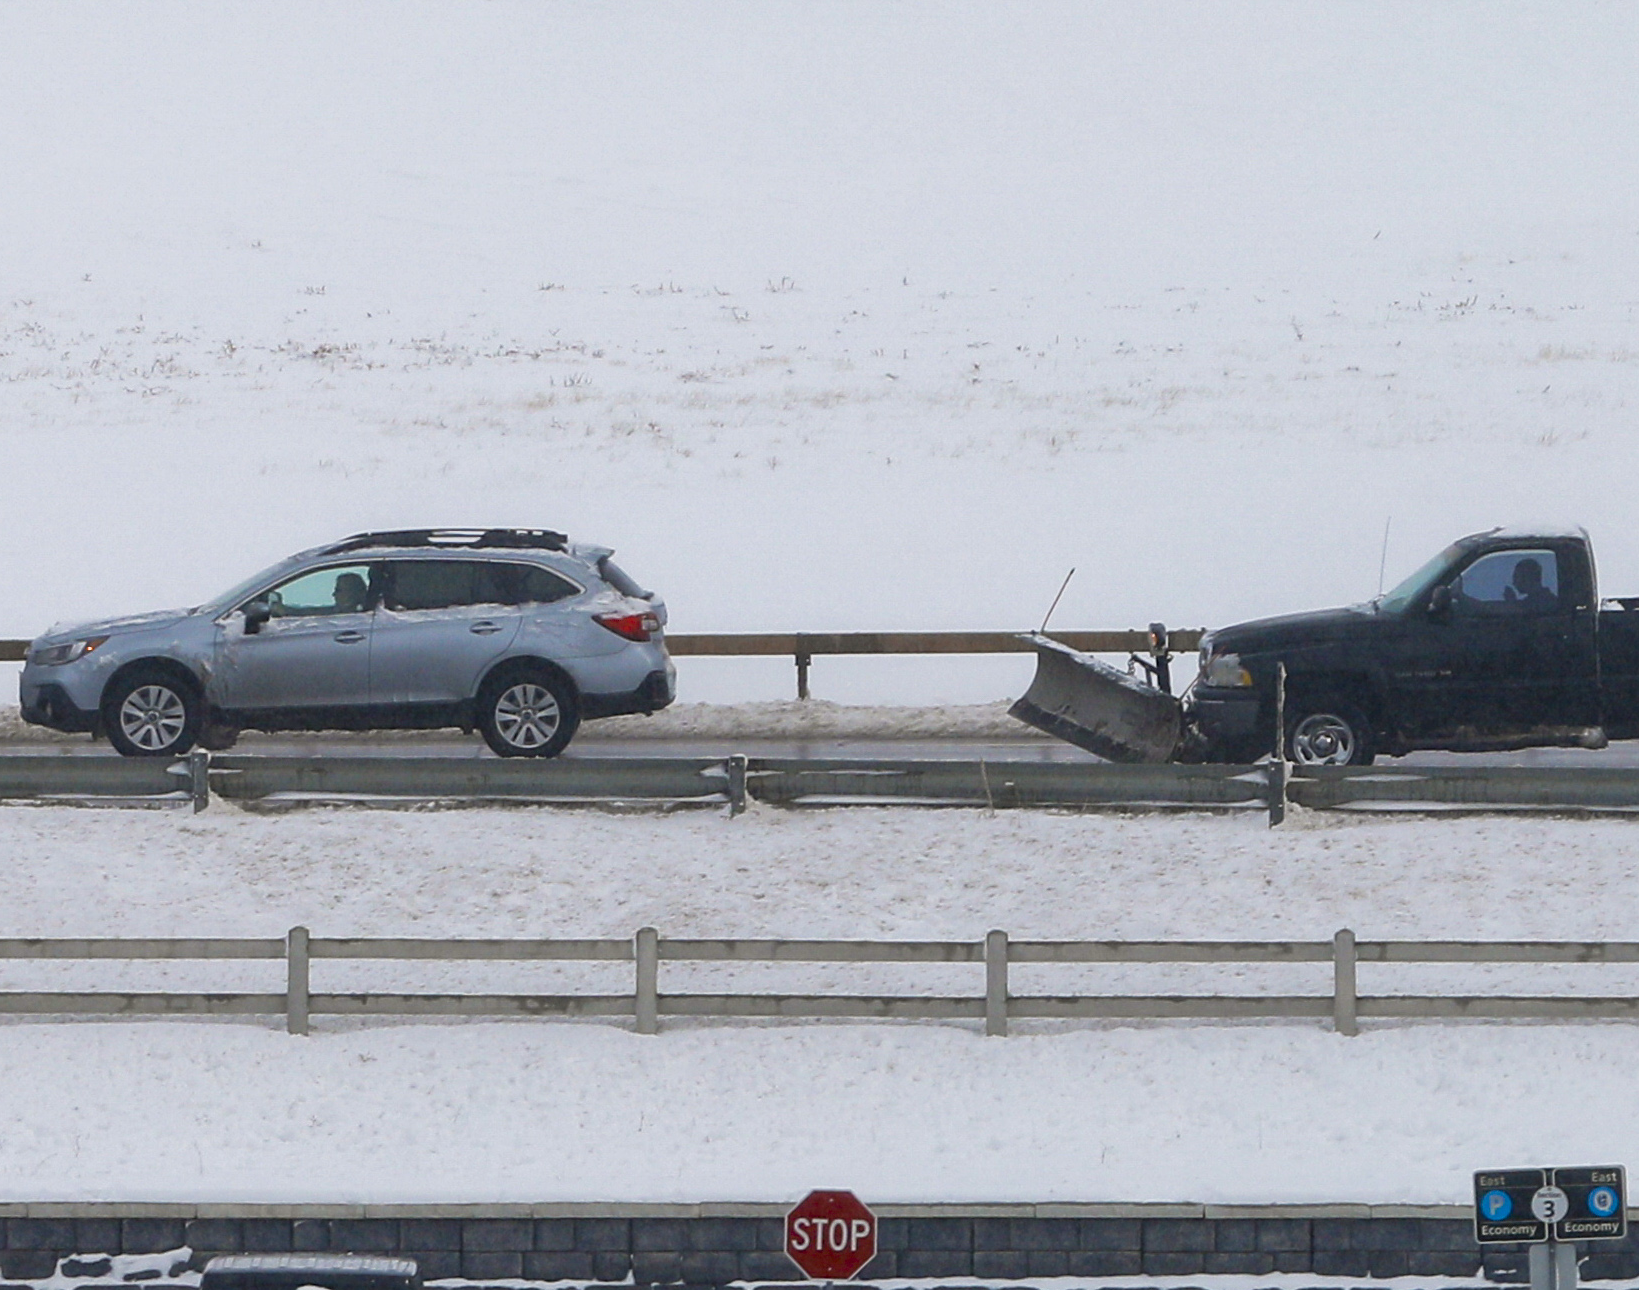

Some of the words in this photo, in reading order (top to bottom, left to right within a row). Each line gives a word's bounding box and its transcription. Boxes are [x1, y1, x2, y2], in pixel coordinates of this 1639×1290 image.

[1480, 1176, 1505, 1186] East
[1591, 1172, 1617, 1183] East
[1490, 1195, 1504, 1215] P
[1544, 1201, 1555, 1217] 3
[1482, 1225, 1537, 1237] Economy
[1565, 1222, 1620, 1233] Economy
[790, 1217, 871, 1252] STOP
